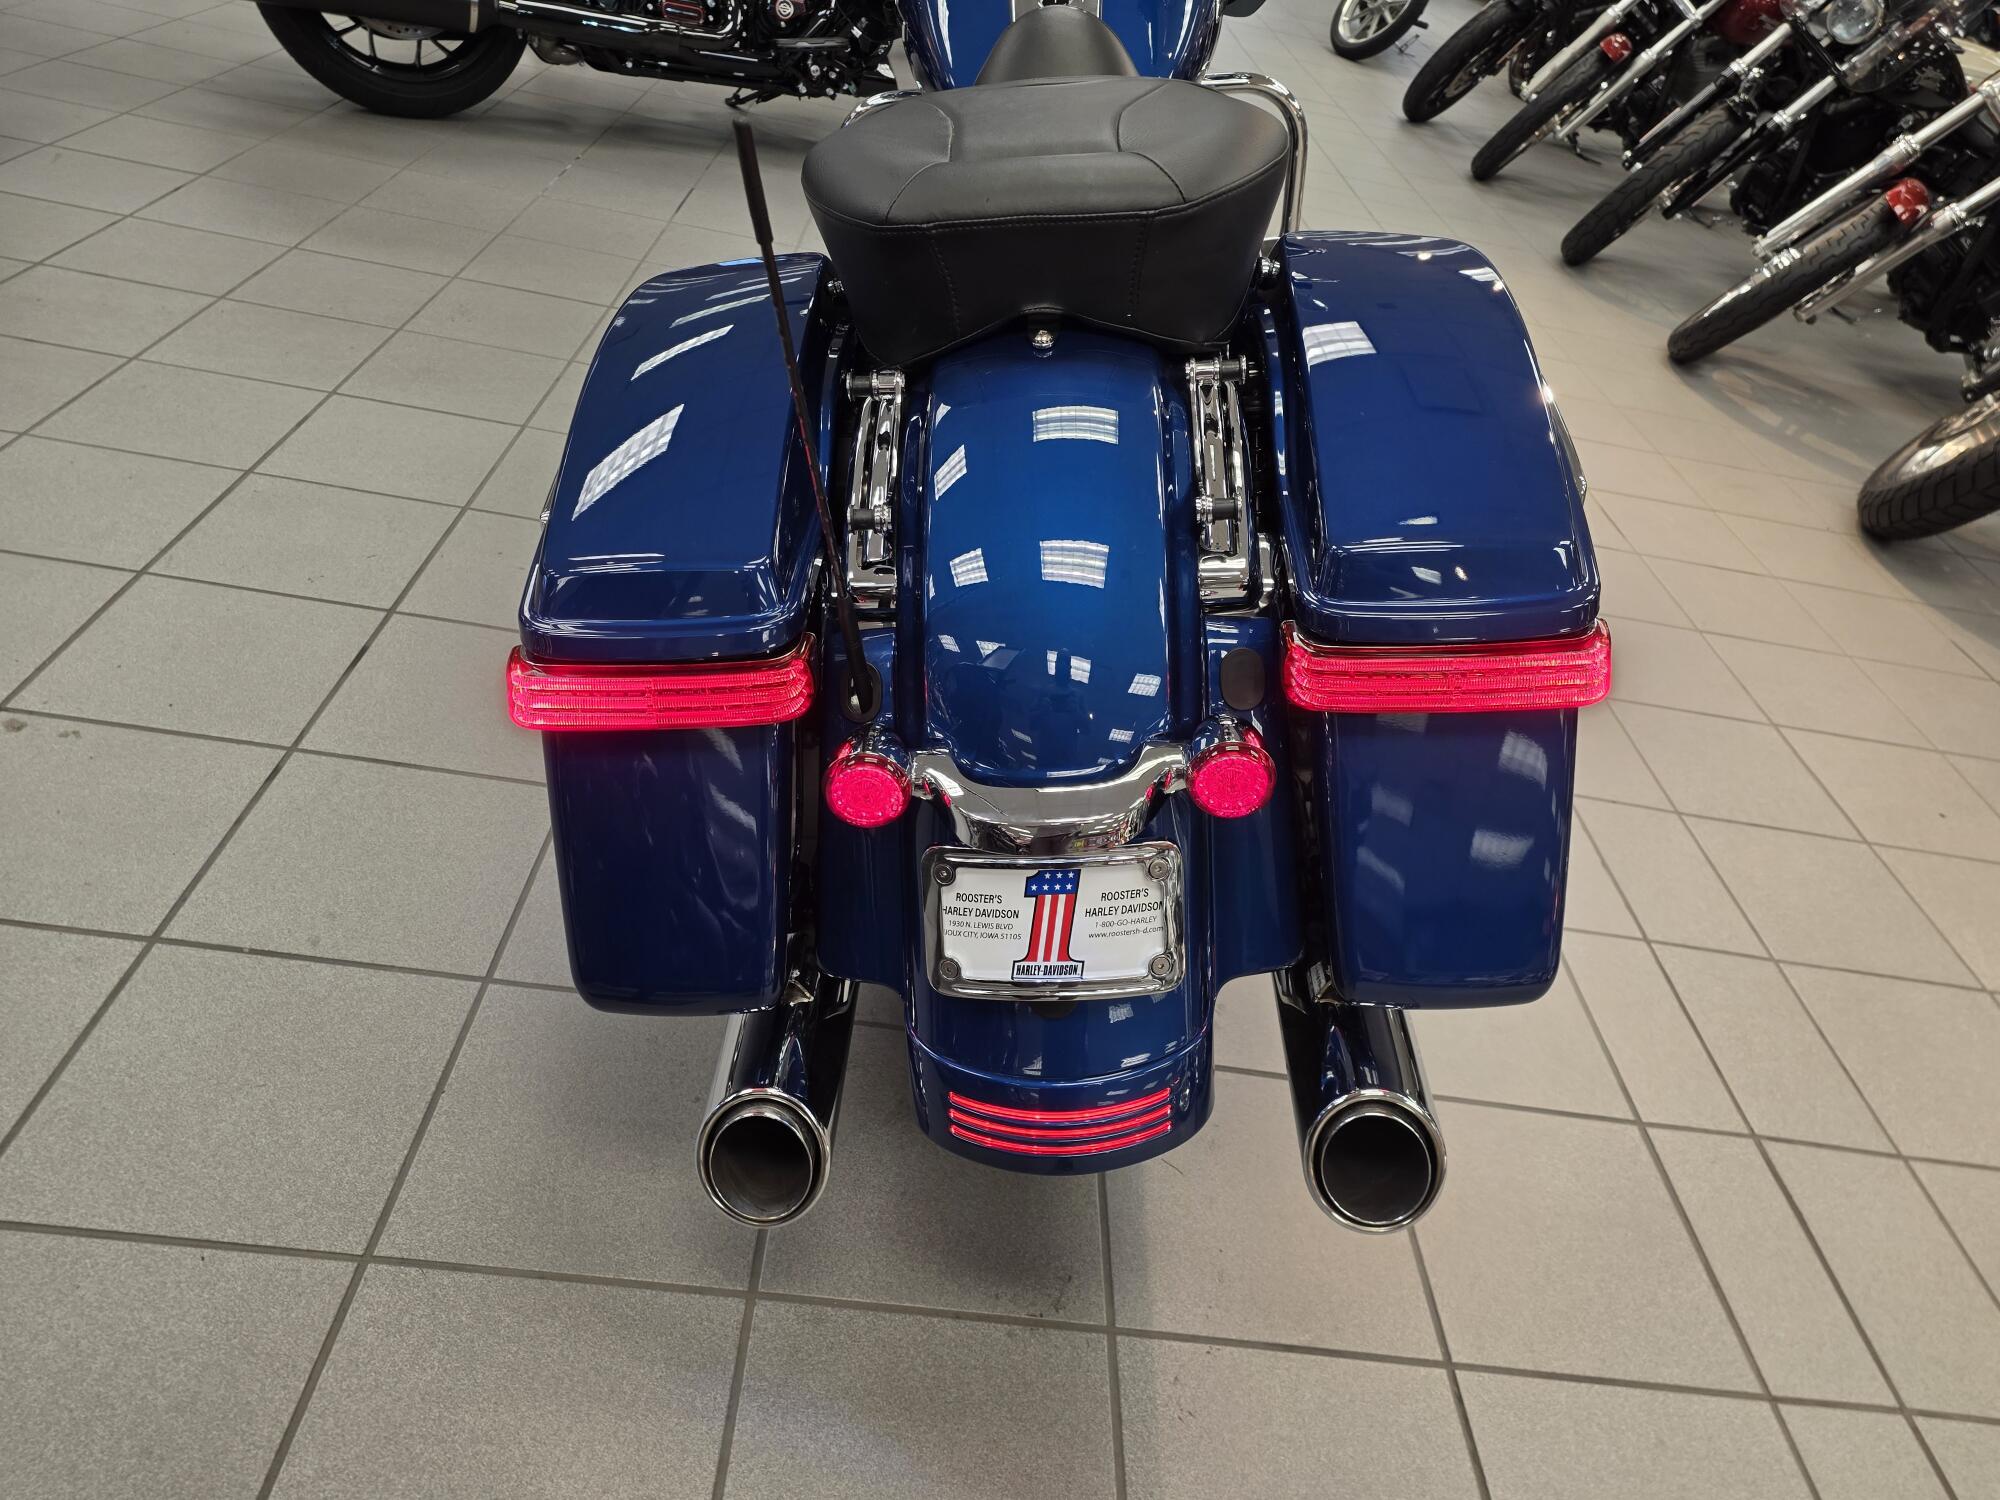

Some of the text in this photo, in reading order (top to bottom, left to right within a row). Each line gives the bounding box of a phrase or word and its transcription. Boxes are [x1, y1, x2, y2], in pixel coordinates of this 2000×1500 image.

[956, 892, 1003, 904] ROOSTER'S
[1101, 888, 1149, 902] ROOSTER'S
[943, 906, 1020, 919] HARLEY DAVIDSON
[1085, 906, 1120, 917] HARLEY
[949, 920, 965, 928] 1930
[965, 921, 973, 929] N.
[973, 922, 994, 930] LEWIS
[1095, 915, 1157, 928] 1-800-GO-HARLEY
[962, 930, 979, 939] CITY,
[1088, 926, 1164, 938] www.roostersh-d.com
[1015, 964, 1079, 976] HARLEY-DAVIDSON
